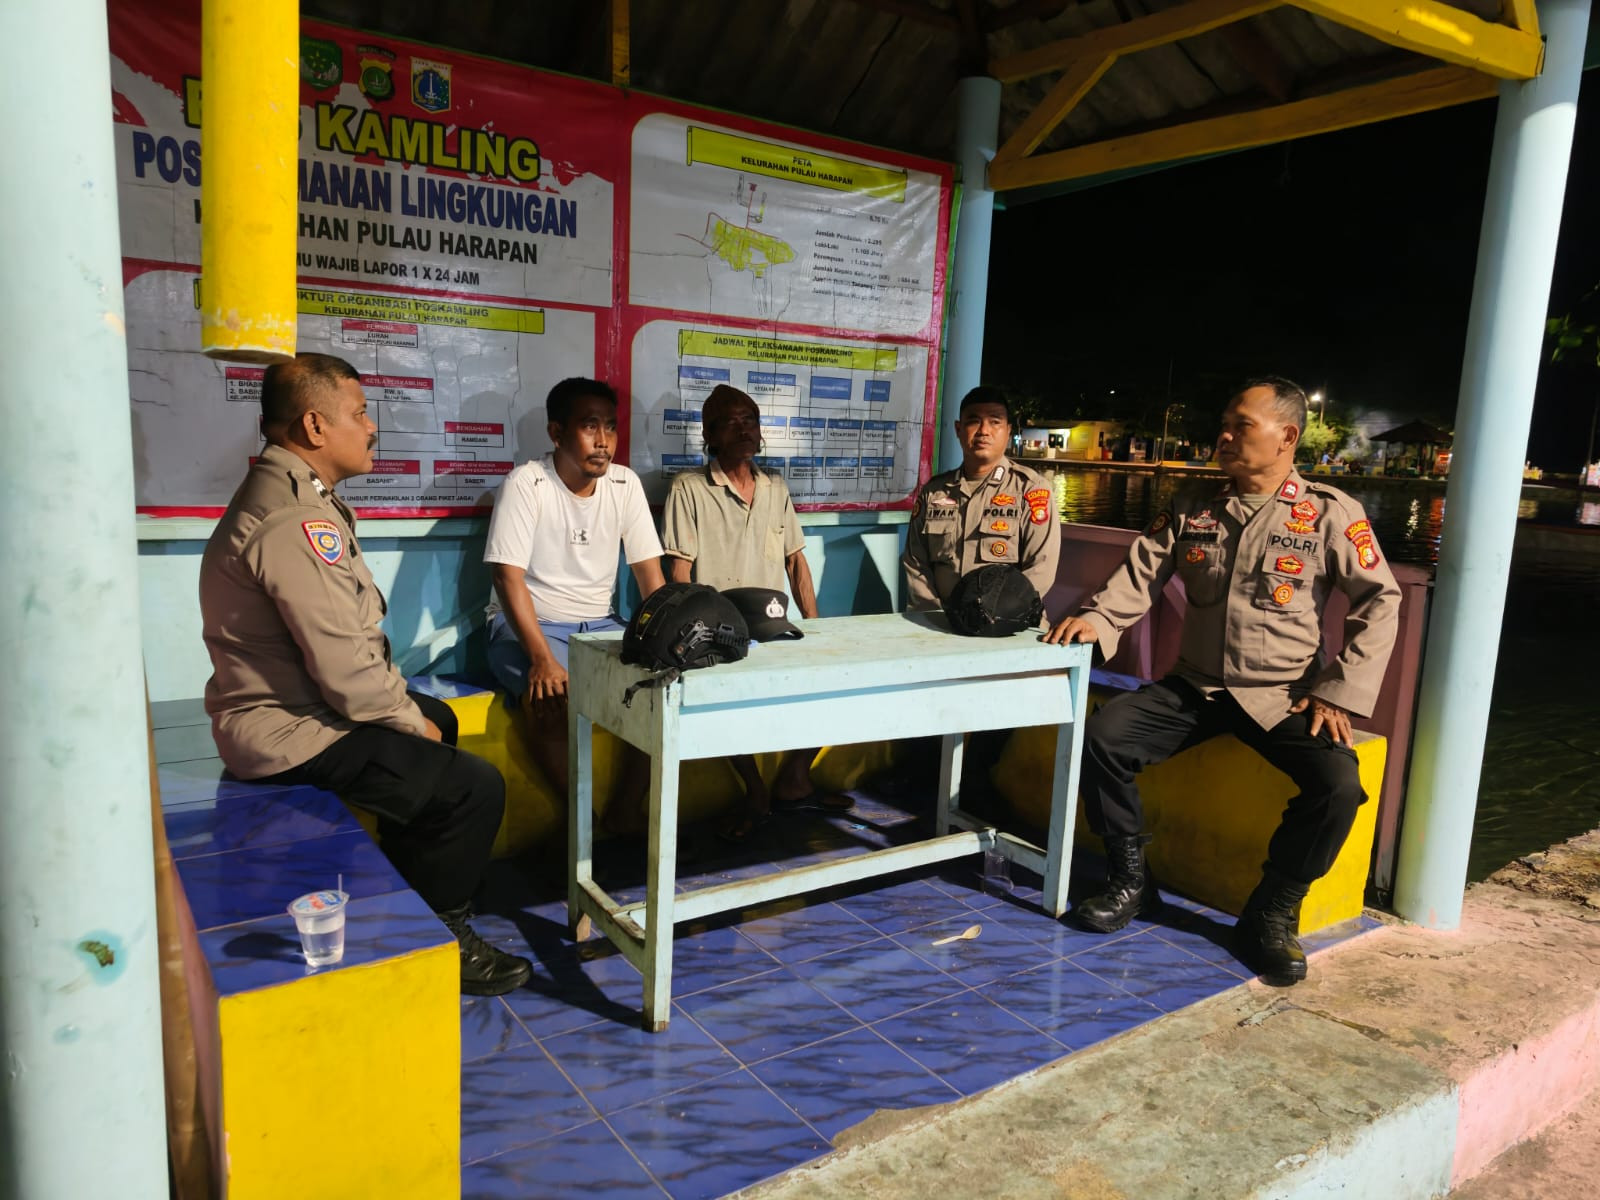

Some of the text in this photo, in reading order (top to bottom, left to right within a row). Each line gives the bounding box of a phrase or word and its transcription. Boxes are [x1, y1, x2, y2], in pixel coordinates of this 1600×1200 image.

[315, 102, 540, 182] KAMLING
[741, 156, 853, 185] KELURAHAN PULAU HARAPAN
[793, 156, 812, 168] PETA
[401, 176, 577, 238] LINGKUNGAN
[358, 218, 433, 252] PULAU
[439, 232, 538, 265] HARAPAN
[316, 254, 359, 272] WAJIB
[364, 259, 407, 277] LAPOR
[412, 268, 418, 279] 1
[421, 268, 432, 281] X
[435, 269, 450, 282] 24
[454, 271, 480, 286] JAM
[324, 305, 468, 326] KELURAHAN PULAU HARAPAN
[338, 295, 412, 311] ORGANISASI
[415, 302, 489, 317] POSKAMLING
[713, 337, 853, 357] JADWAL PELAKSANAAN POSKAMLING
[747, 350, 785, 360] KELURAHAN
[787, 354, 809, 363] PULAU
[928, 508, 955, 518] IWAN
[983, 508, 1018, 517] POLRI
[1271, 535, 1318, 554] POLRI
